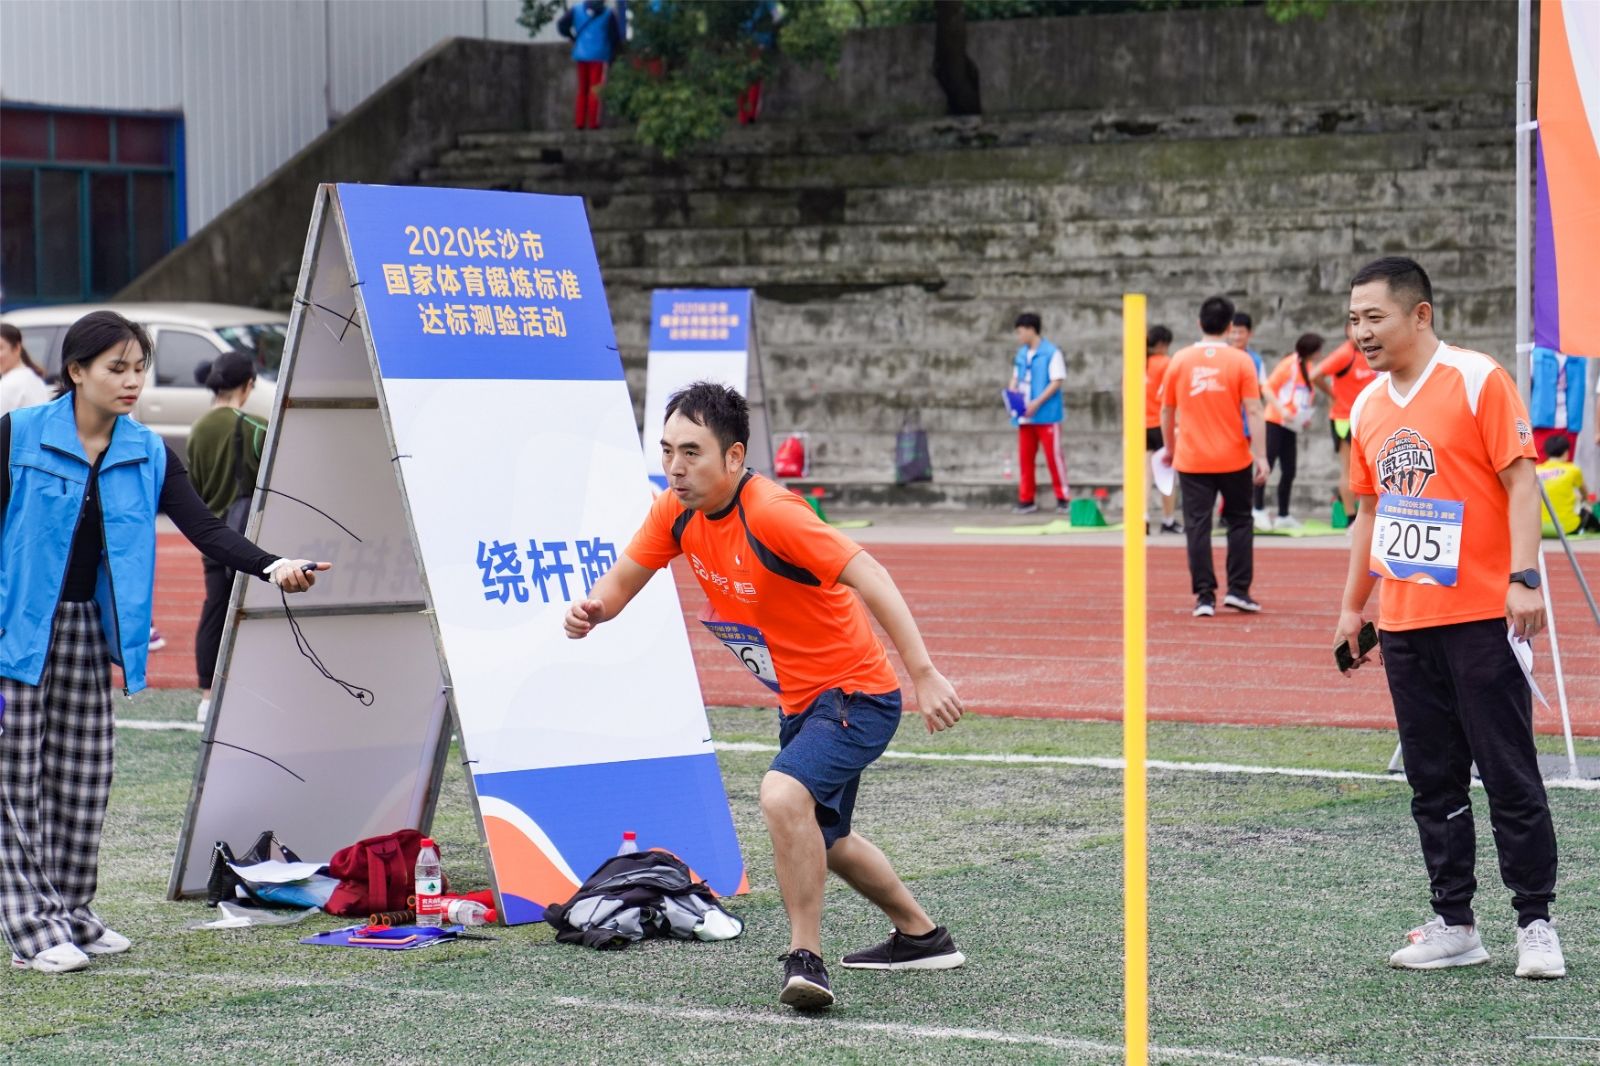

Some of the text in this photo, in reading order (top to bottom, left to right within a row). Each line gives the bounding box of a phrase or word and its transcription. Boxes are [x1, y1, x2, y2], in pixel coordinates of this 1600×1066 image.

[404, 225, 544, 262] 2020长沙市
[382, 263, 583, 301] 国家体育锻炼标准
[417, 302, 567, 338] 达标测验活动
[1382, 450, 1430, 477] 微马队
[1386, 521, 1442, 562] 205
